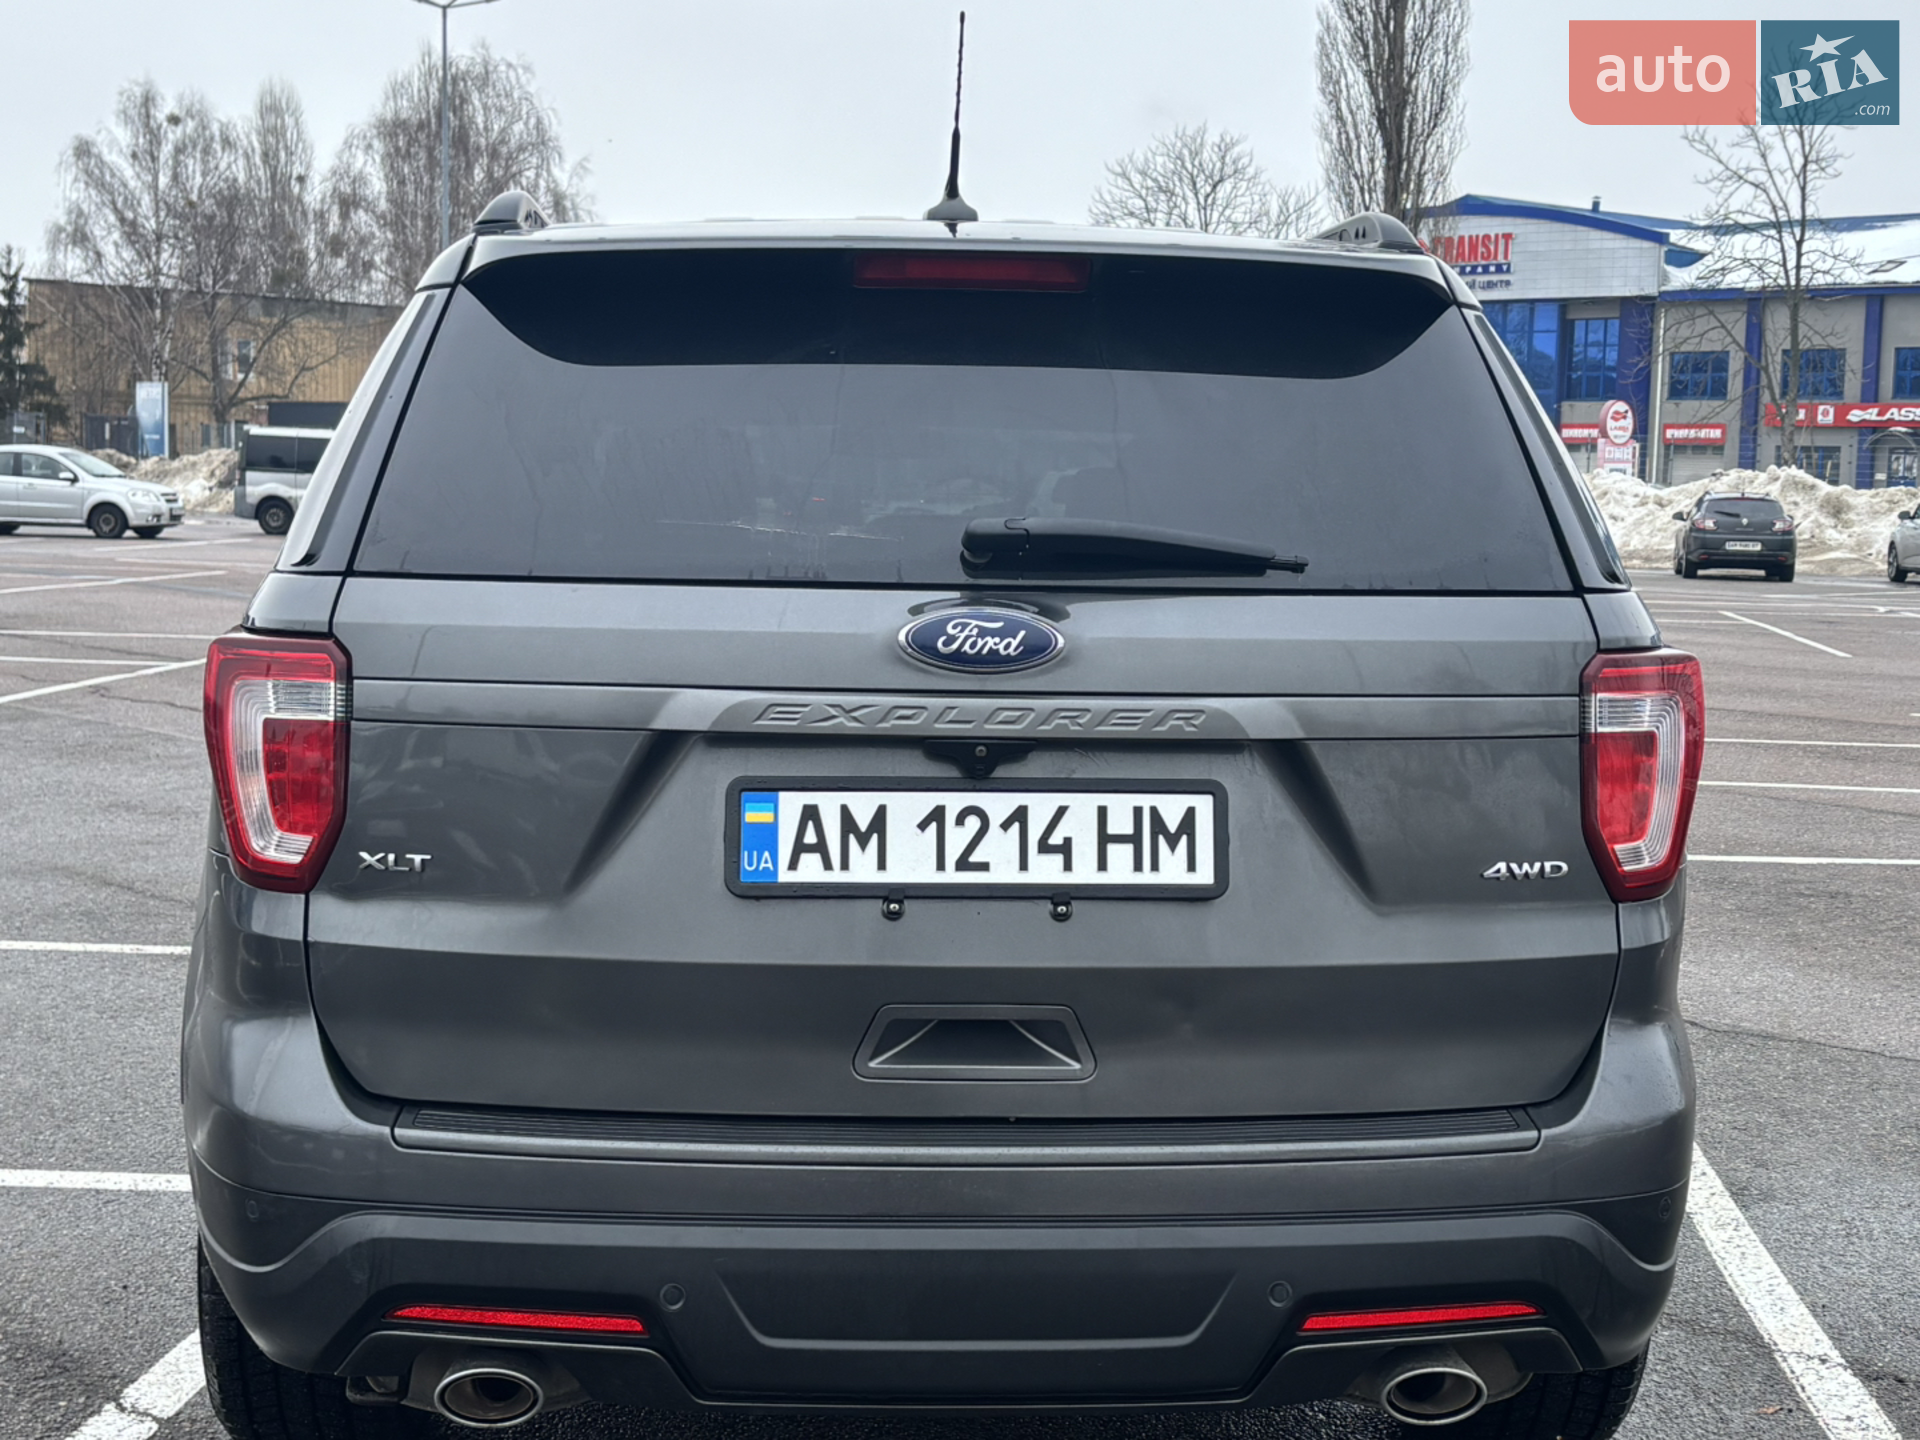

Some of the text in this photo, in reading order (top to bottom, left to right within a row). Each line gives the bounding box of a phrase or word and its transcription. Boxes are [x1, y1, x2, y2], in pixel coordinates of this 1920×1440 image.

[937, 619, 1025, 657] Ford
[752, 703, 1206, 732] EXPLORER
[786, 803, 1197, 873] AM 1214 HM
[358, 851, 432, 872] XLT
[743, 849, 774, 871] UA
[1482, 860, 1569, 880] 4WD
